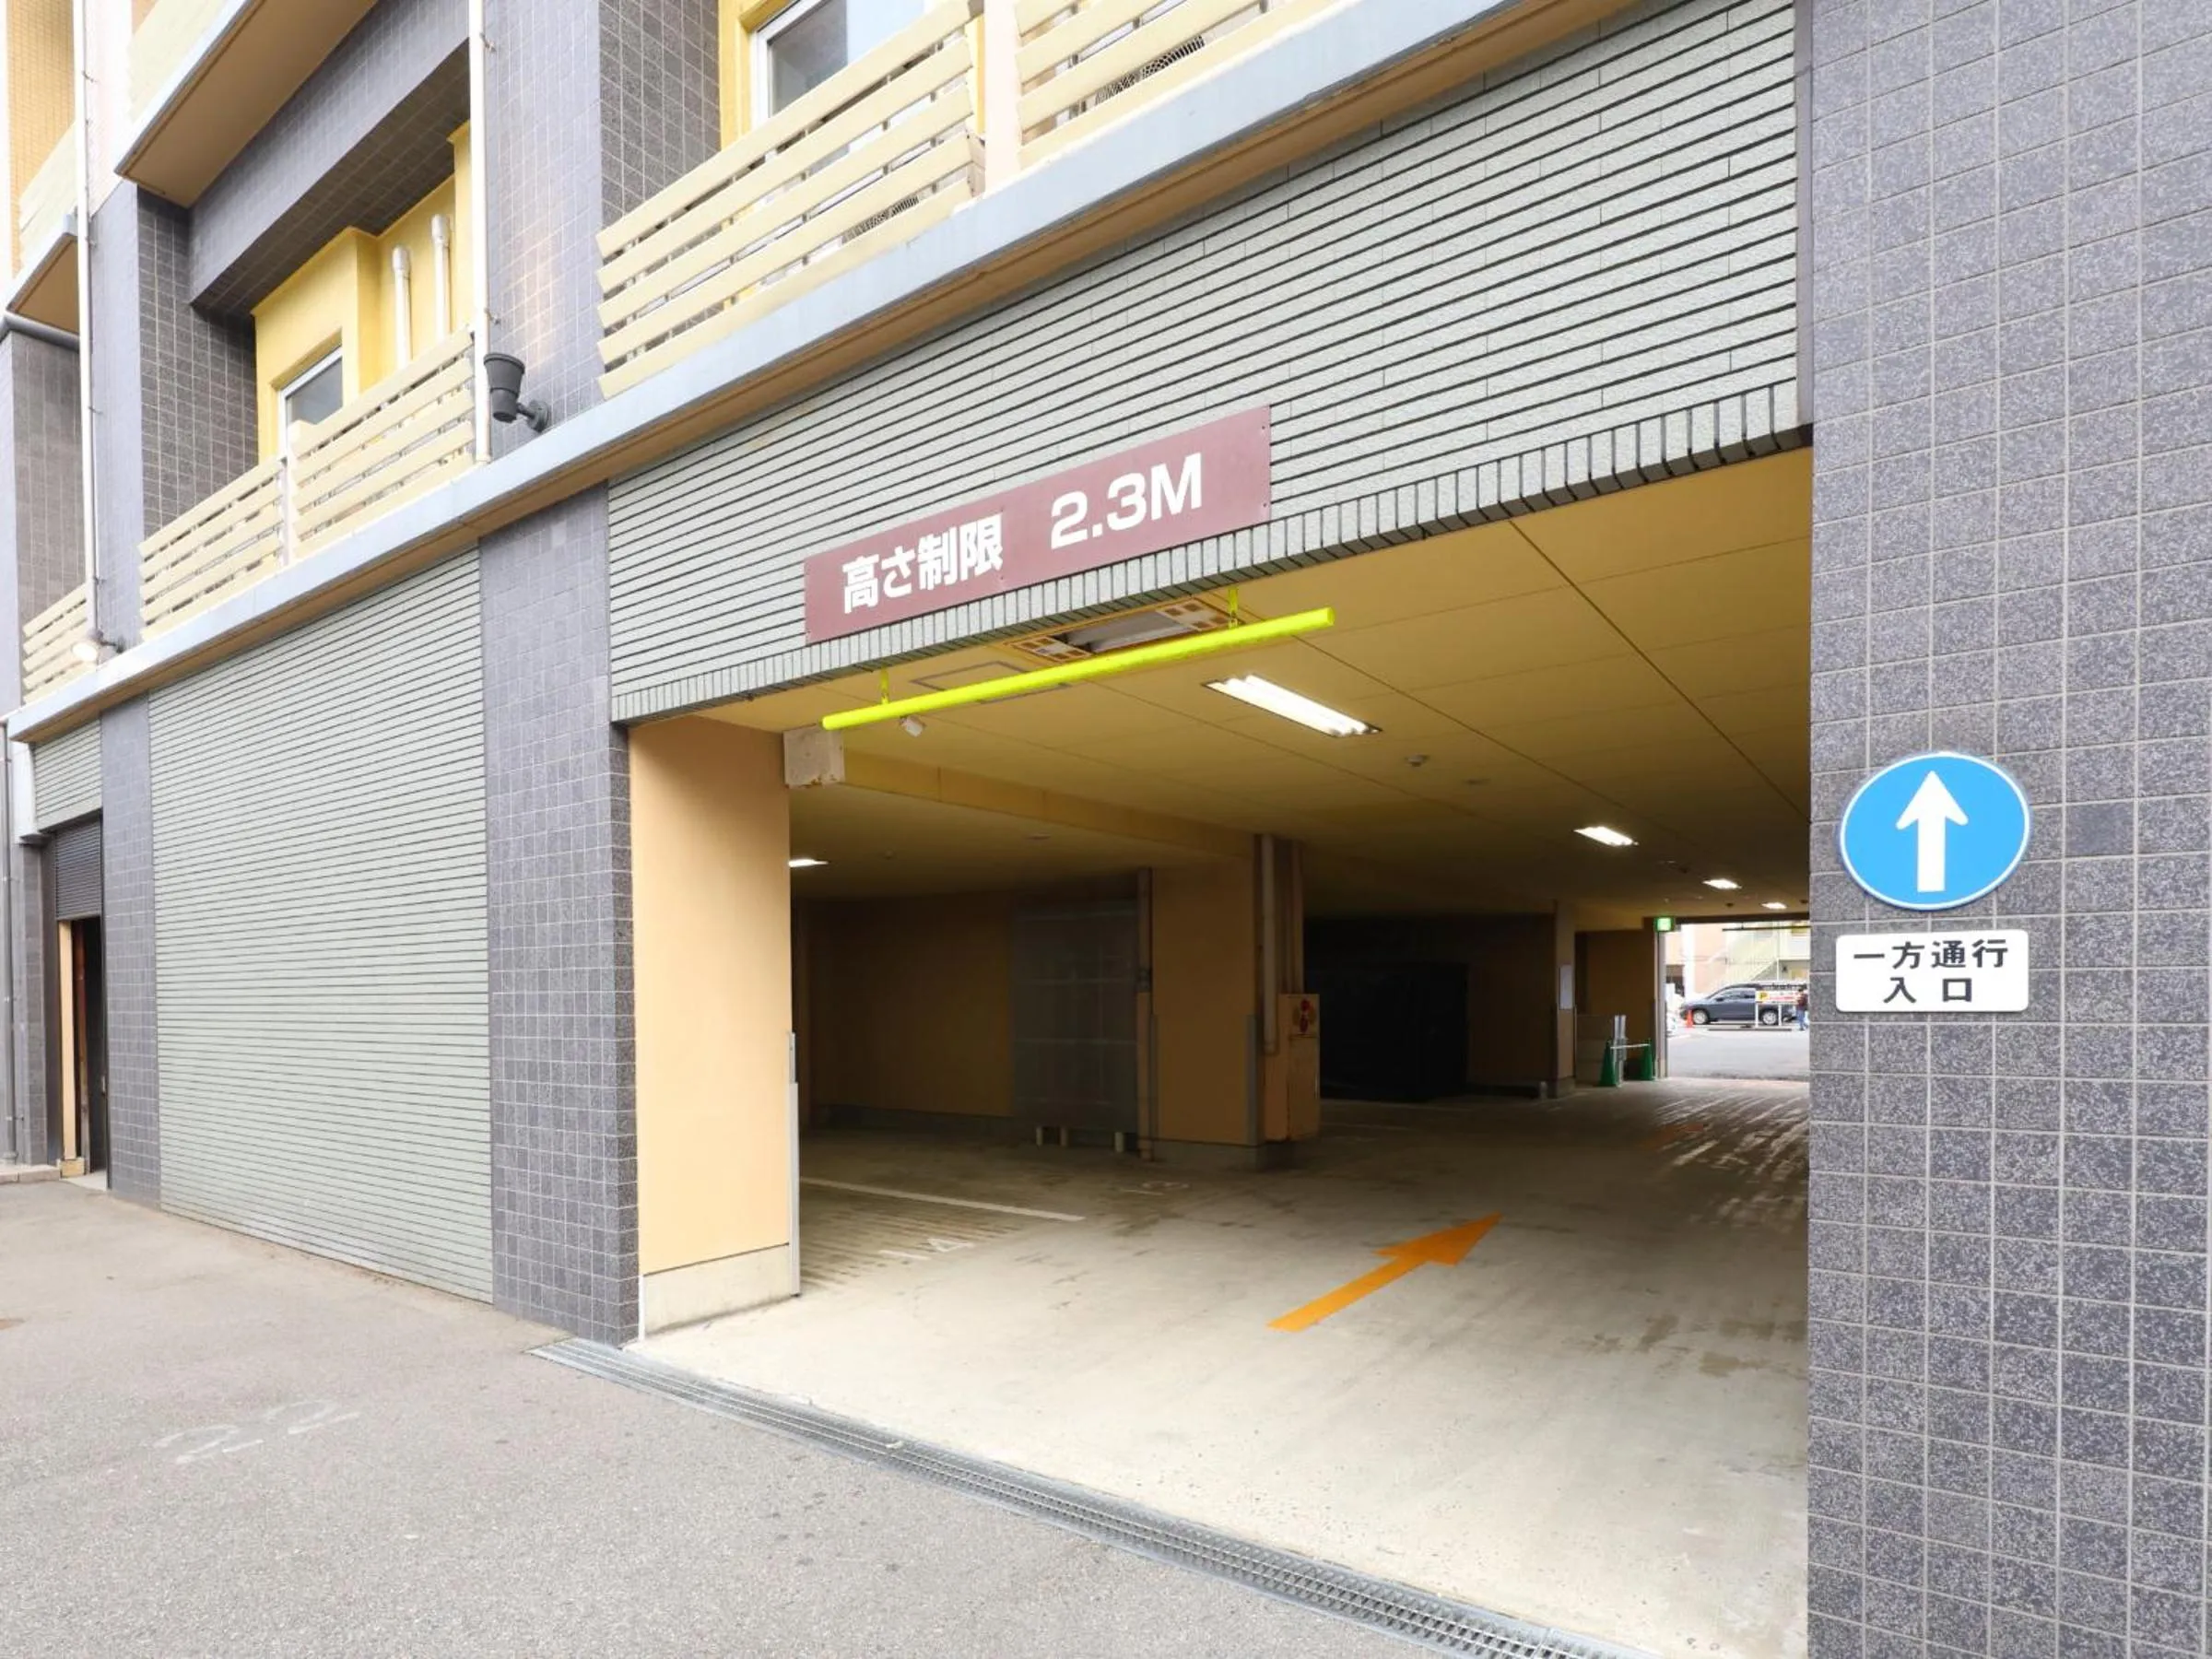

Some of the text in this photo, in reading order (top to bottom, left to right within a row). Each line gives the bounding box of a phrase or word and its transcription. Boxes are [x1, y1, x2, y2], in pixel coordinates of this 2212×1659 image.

[841, 452, 1202, 615] 高さ制限 2.3M
[1853, 938, 2008, 970] 一方通行
